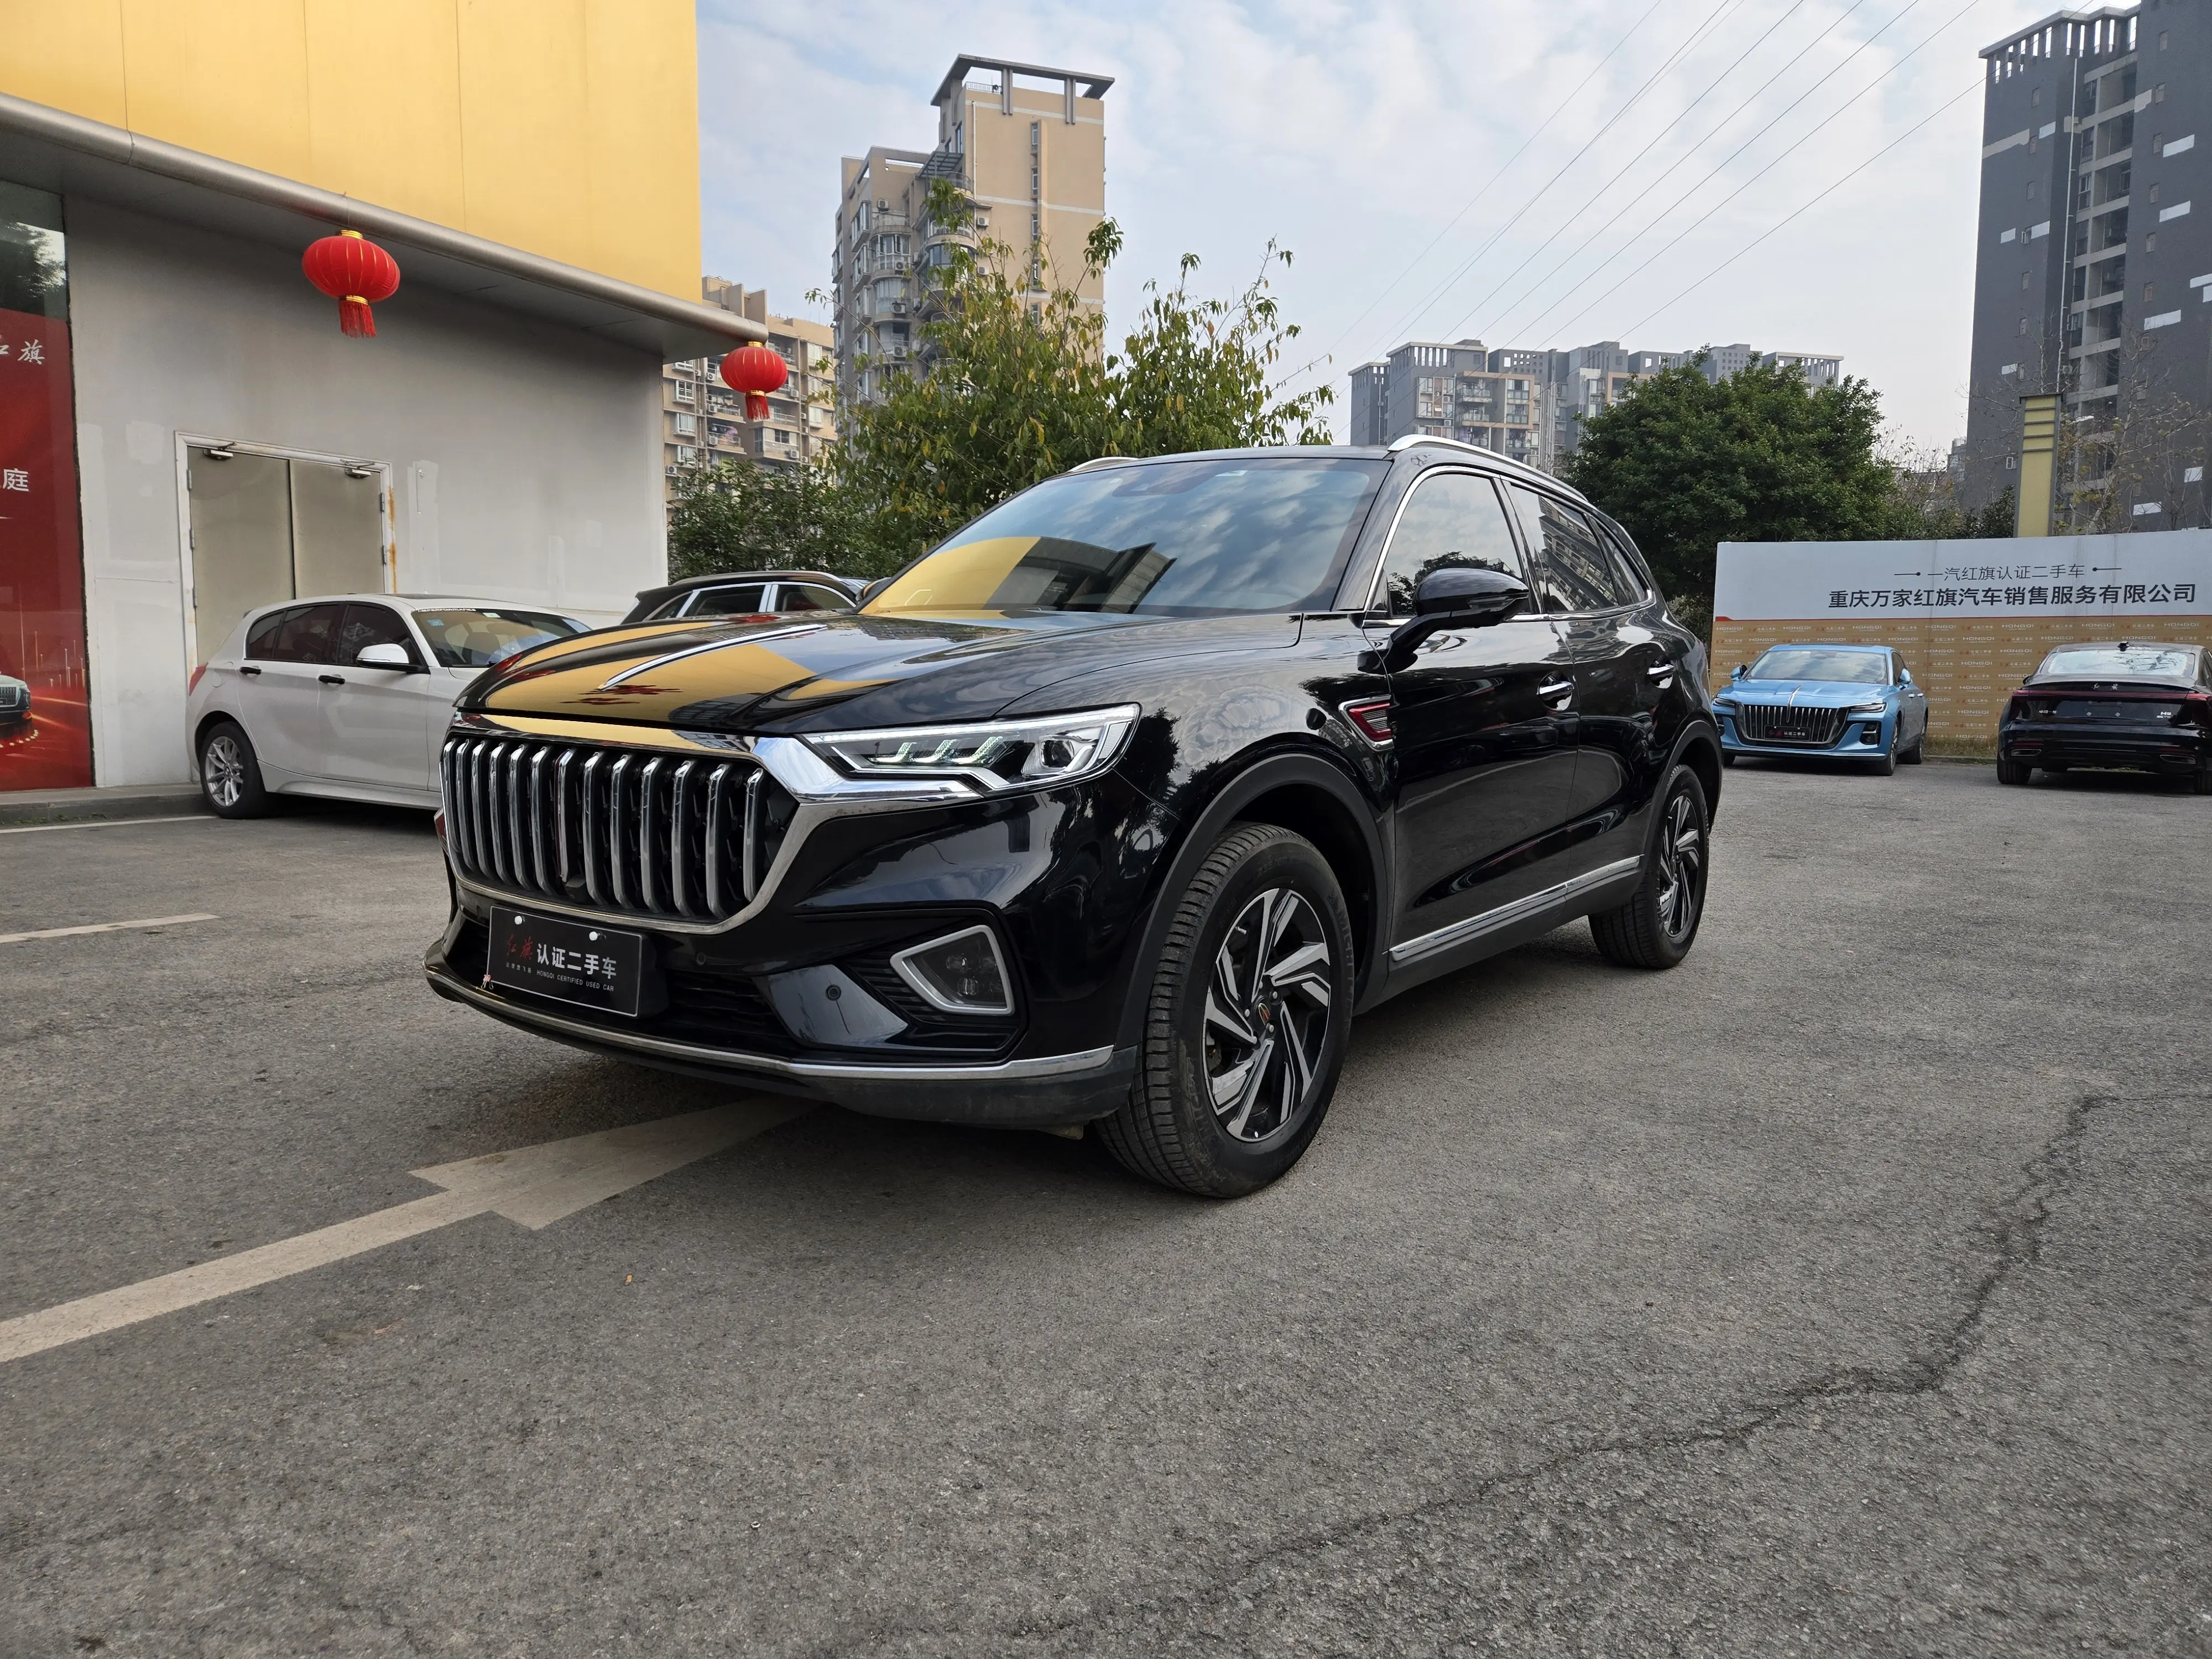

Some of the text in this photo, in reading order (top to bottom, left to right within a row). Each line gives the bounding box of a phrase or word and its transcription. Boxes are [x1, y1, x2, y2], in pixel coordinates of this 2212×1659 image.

[0, 468, 29, 491] 庭
[1927, 564, 2085, 581] 一汽红旗认证二手车
[1828, 583, 2195, 608] 重庆万家红旗汽车销售服务有限公司
[536, 969, 555, 979] HONGQI
[557, 974, 583, 985] CERTIFIED
[586, 980, 600, 989] USED
